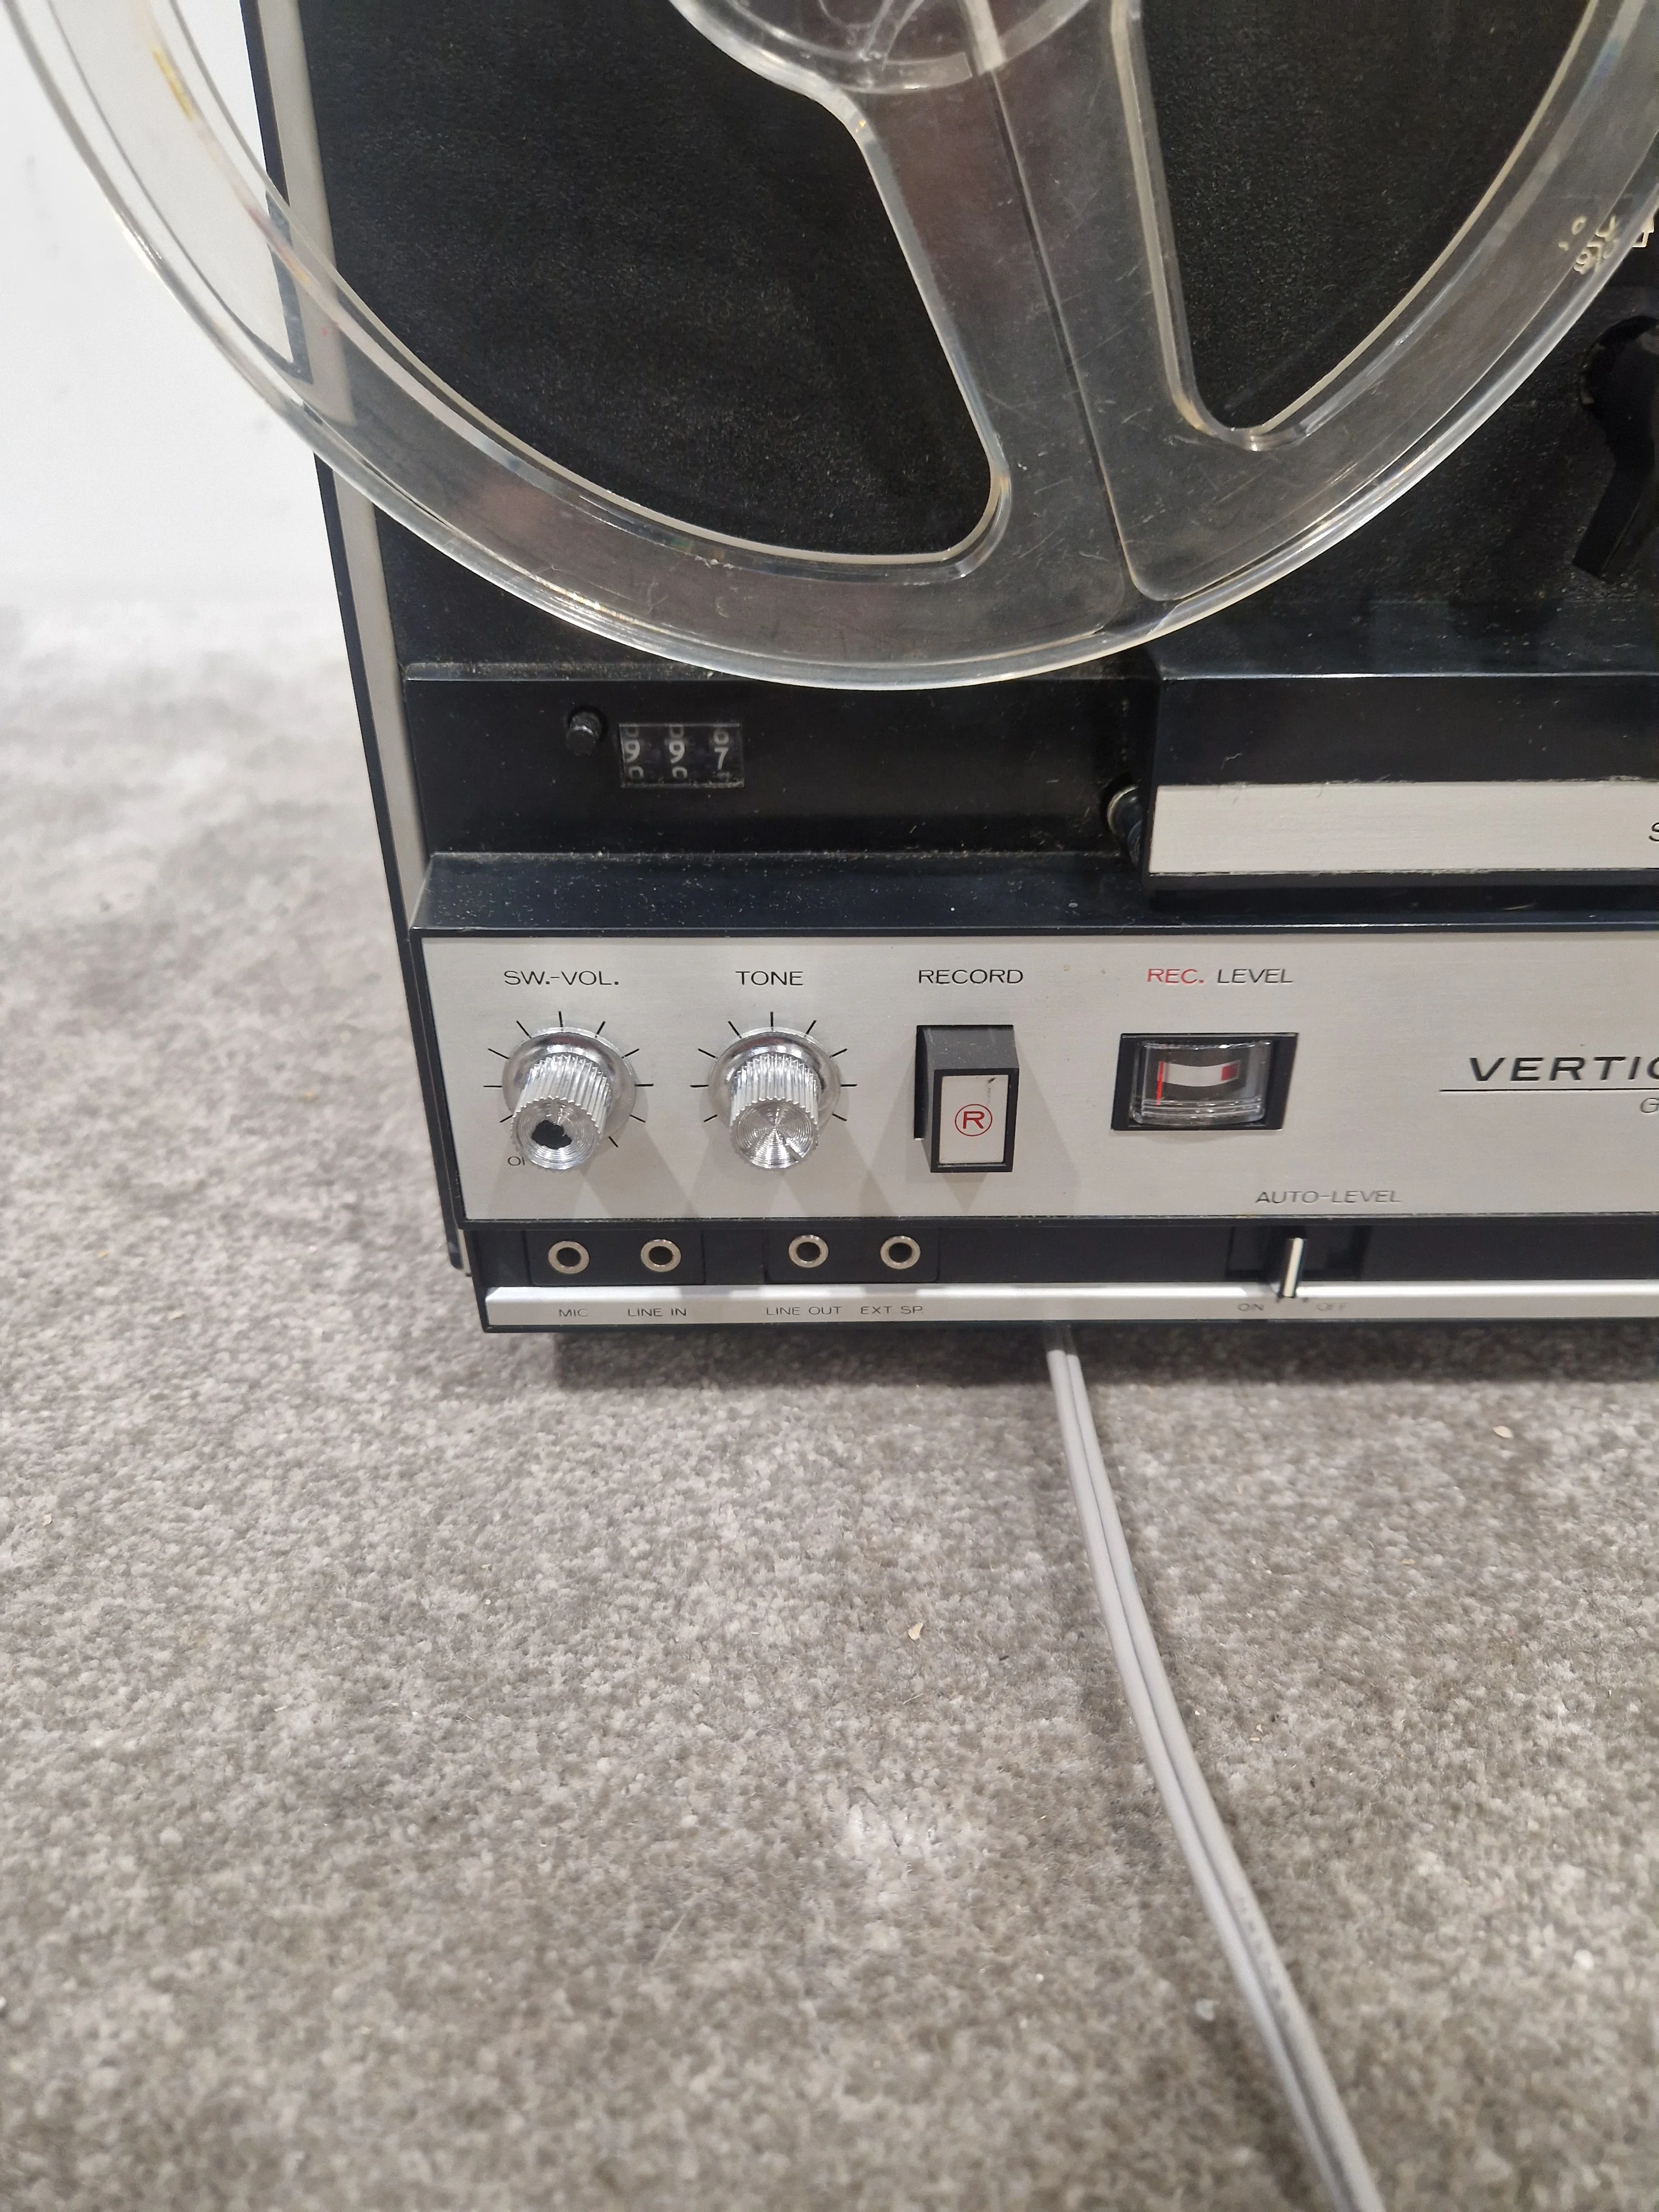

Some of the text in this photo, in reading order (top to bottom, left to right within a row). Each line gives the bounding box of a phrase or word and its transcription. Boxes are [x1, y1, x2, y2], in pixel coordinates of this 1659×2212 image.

[504, 971, 619, 985] SW.-VOL.
[735, 971, 804, 985] TONE
[918, 969, 1024, 984] RECORD
[1147, 968, 1293, 984] REC. LEVEL
[1255, 1190, 1402, 1204] AUTO-LEVEL
[559, 1309, 588, 1317] MIC
[628, 1308, 686, 1317] LINE IN
[766, 1306, 842, 1316] LINE OUT
[860, 1306, 893, 1314] EXT
